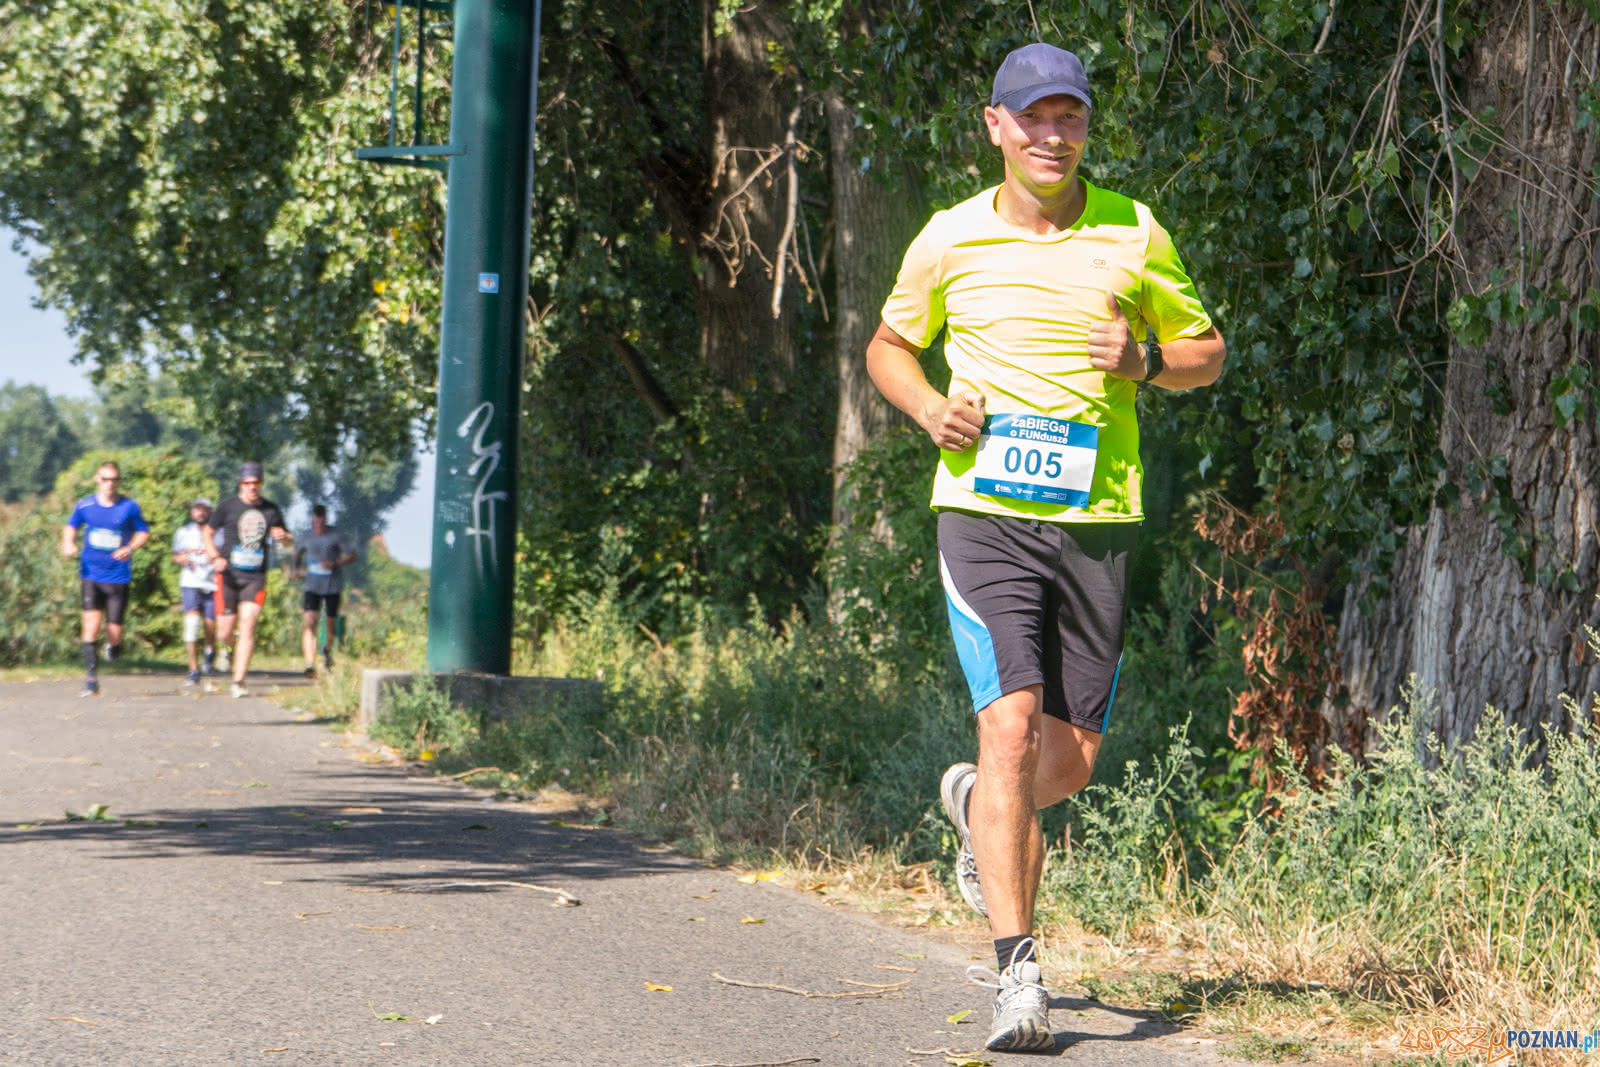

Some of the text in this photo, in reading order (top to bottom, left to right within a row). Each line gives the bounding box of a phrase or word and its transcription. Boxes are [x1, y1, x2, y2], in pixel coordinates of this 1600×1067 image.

[1011, 418, 1070, 436] zaBIEGaj
[1019, 430, 1068, 444] FUNdusze
[1004, 446, 1063, 478] 005
